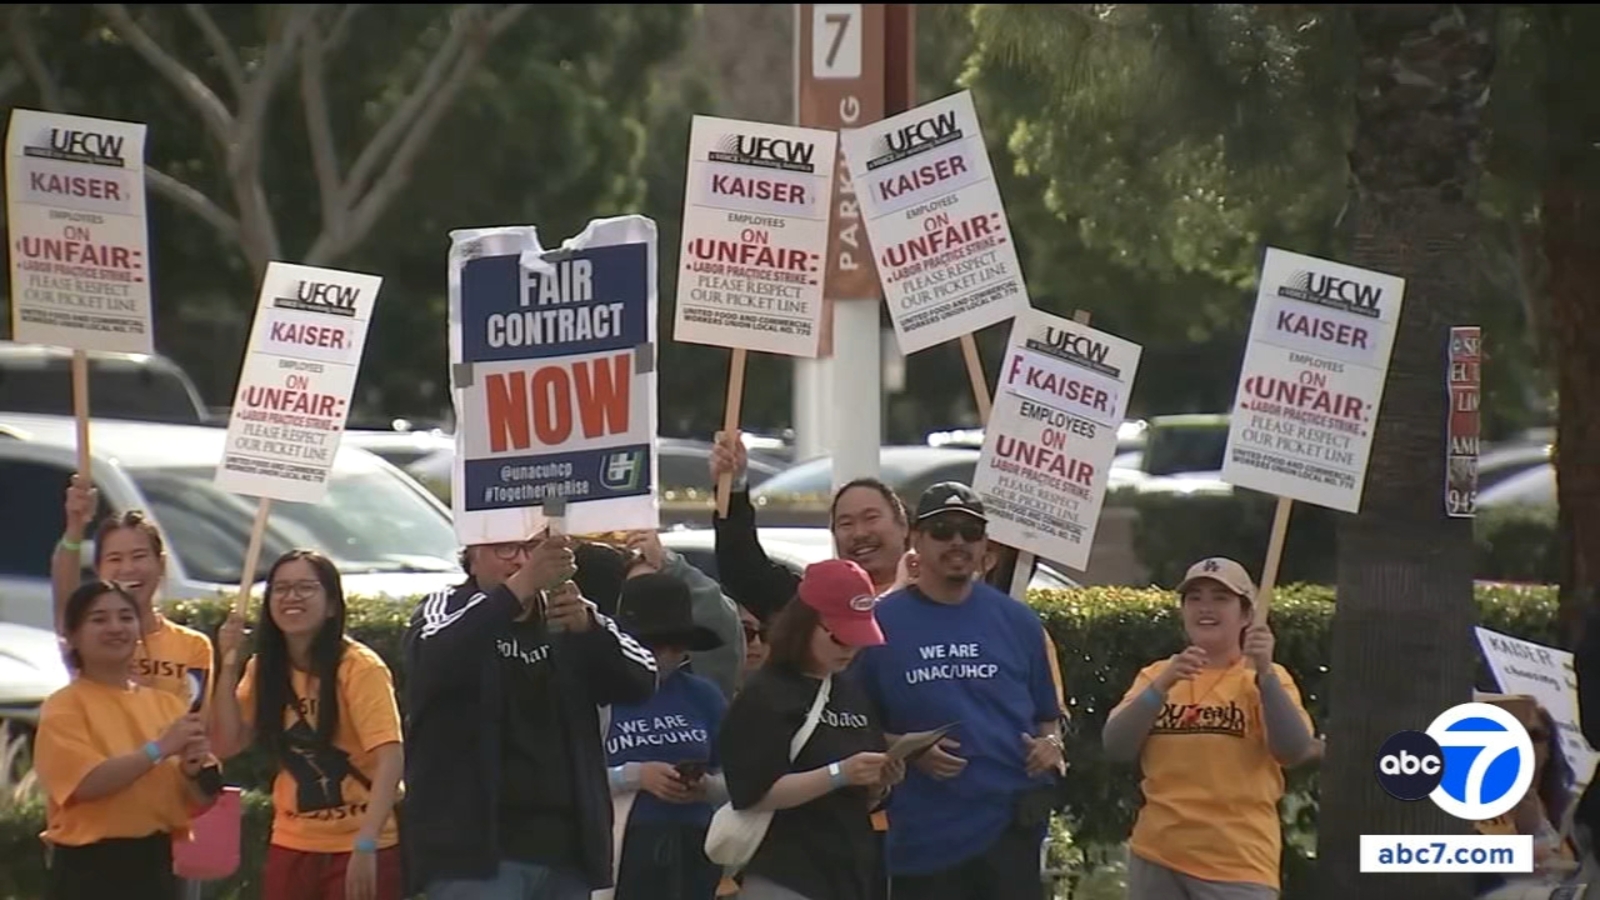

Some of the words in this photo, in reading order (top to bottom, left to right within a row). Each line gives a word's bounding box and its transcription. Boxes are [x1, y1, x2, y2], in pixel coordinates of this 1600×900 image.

[825, 13, 851, 68] 7
[53, 128, 123, 158] UFCW
[885, 110, 957, 154] UFCW
[736, 135, 813, 163] UFCW
[30, 171, 119, 200] KAISER
[712, 175, 805, 203] KAISER
[879, 152, 966, 200] KAISER
[728, 213, 784, 227] EMPLOYEES
[905, 193, 958, 219] EMPLOYEES
[63, 225, 89, 241] ON
[740, 228, 767, 243] ON
[922, 211, 949, 232] ON
[519, 259, 594, 307] FAIR
[902, 269, 944, 293] PLEASE
[946, 250, 997, 278] RESPECT
[296, 281, 360, 307] UFCW
[697, 275, 743, 291] PLEASE
[746, 281, 801, 298] RESPECT
[900, 289, 931, 310] OUR
[932, 273, 977, 298] PICKET
[979, 262, 1007, 281] LINE
[1304, 272, 1381, 308] UFCW
[690, 289, 722, 303] OUR
[726, 293, 774, 309] PICKET
[777, 299, 807, 313] LINE
[269, 322, 346, 348] KAISER
[487, 303, 624, 348] CONTRACT
[1276, 310, 1369, 349] KAISER
[1045, 327, 1109, 362] UFCW
[1289, 352, 1344, 373] EMPLOYEES
[285, 374, 309, 390] ON
[1025, 367, 1109, 410] KAISER
[1299, 369, 1326, 387] ON
[485, 353, 631, 453] NOW
[1019, 401, 1096, 438] EMPLOYEES
[1251, 415, 1296, 435] PLEASE
[1298, 426, 1350, 448] RESPECT
[1040, 427, 1066, 450] ON
[1241, 428, 1272, 446] OUR
[1276, 436, 1322, 457] PICKET
[1325, 448, 1354, 465] LINE
[501, 462, 573, 482] @unacuhcp
[994, 434, 1096, 485] UNFAIR
[485, 479, 590, 503] #TogetherWeRise
[919, 644, 946, 660] WE
[948, 643, 980, 659] ARE
[1489, 636, 1554, 668] KAISER
[905, 664, 999, 685] UNAC/UHCP
[616, 719, 651, 734] WE
[653, 714, 690, 730] ARE
